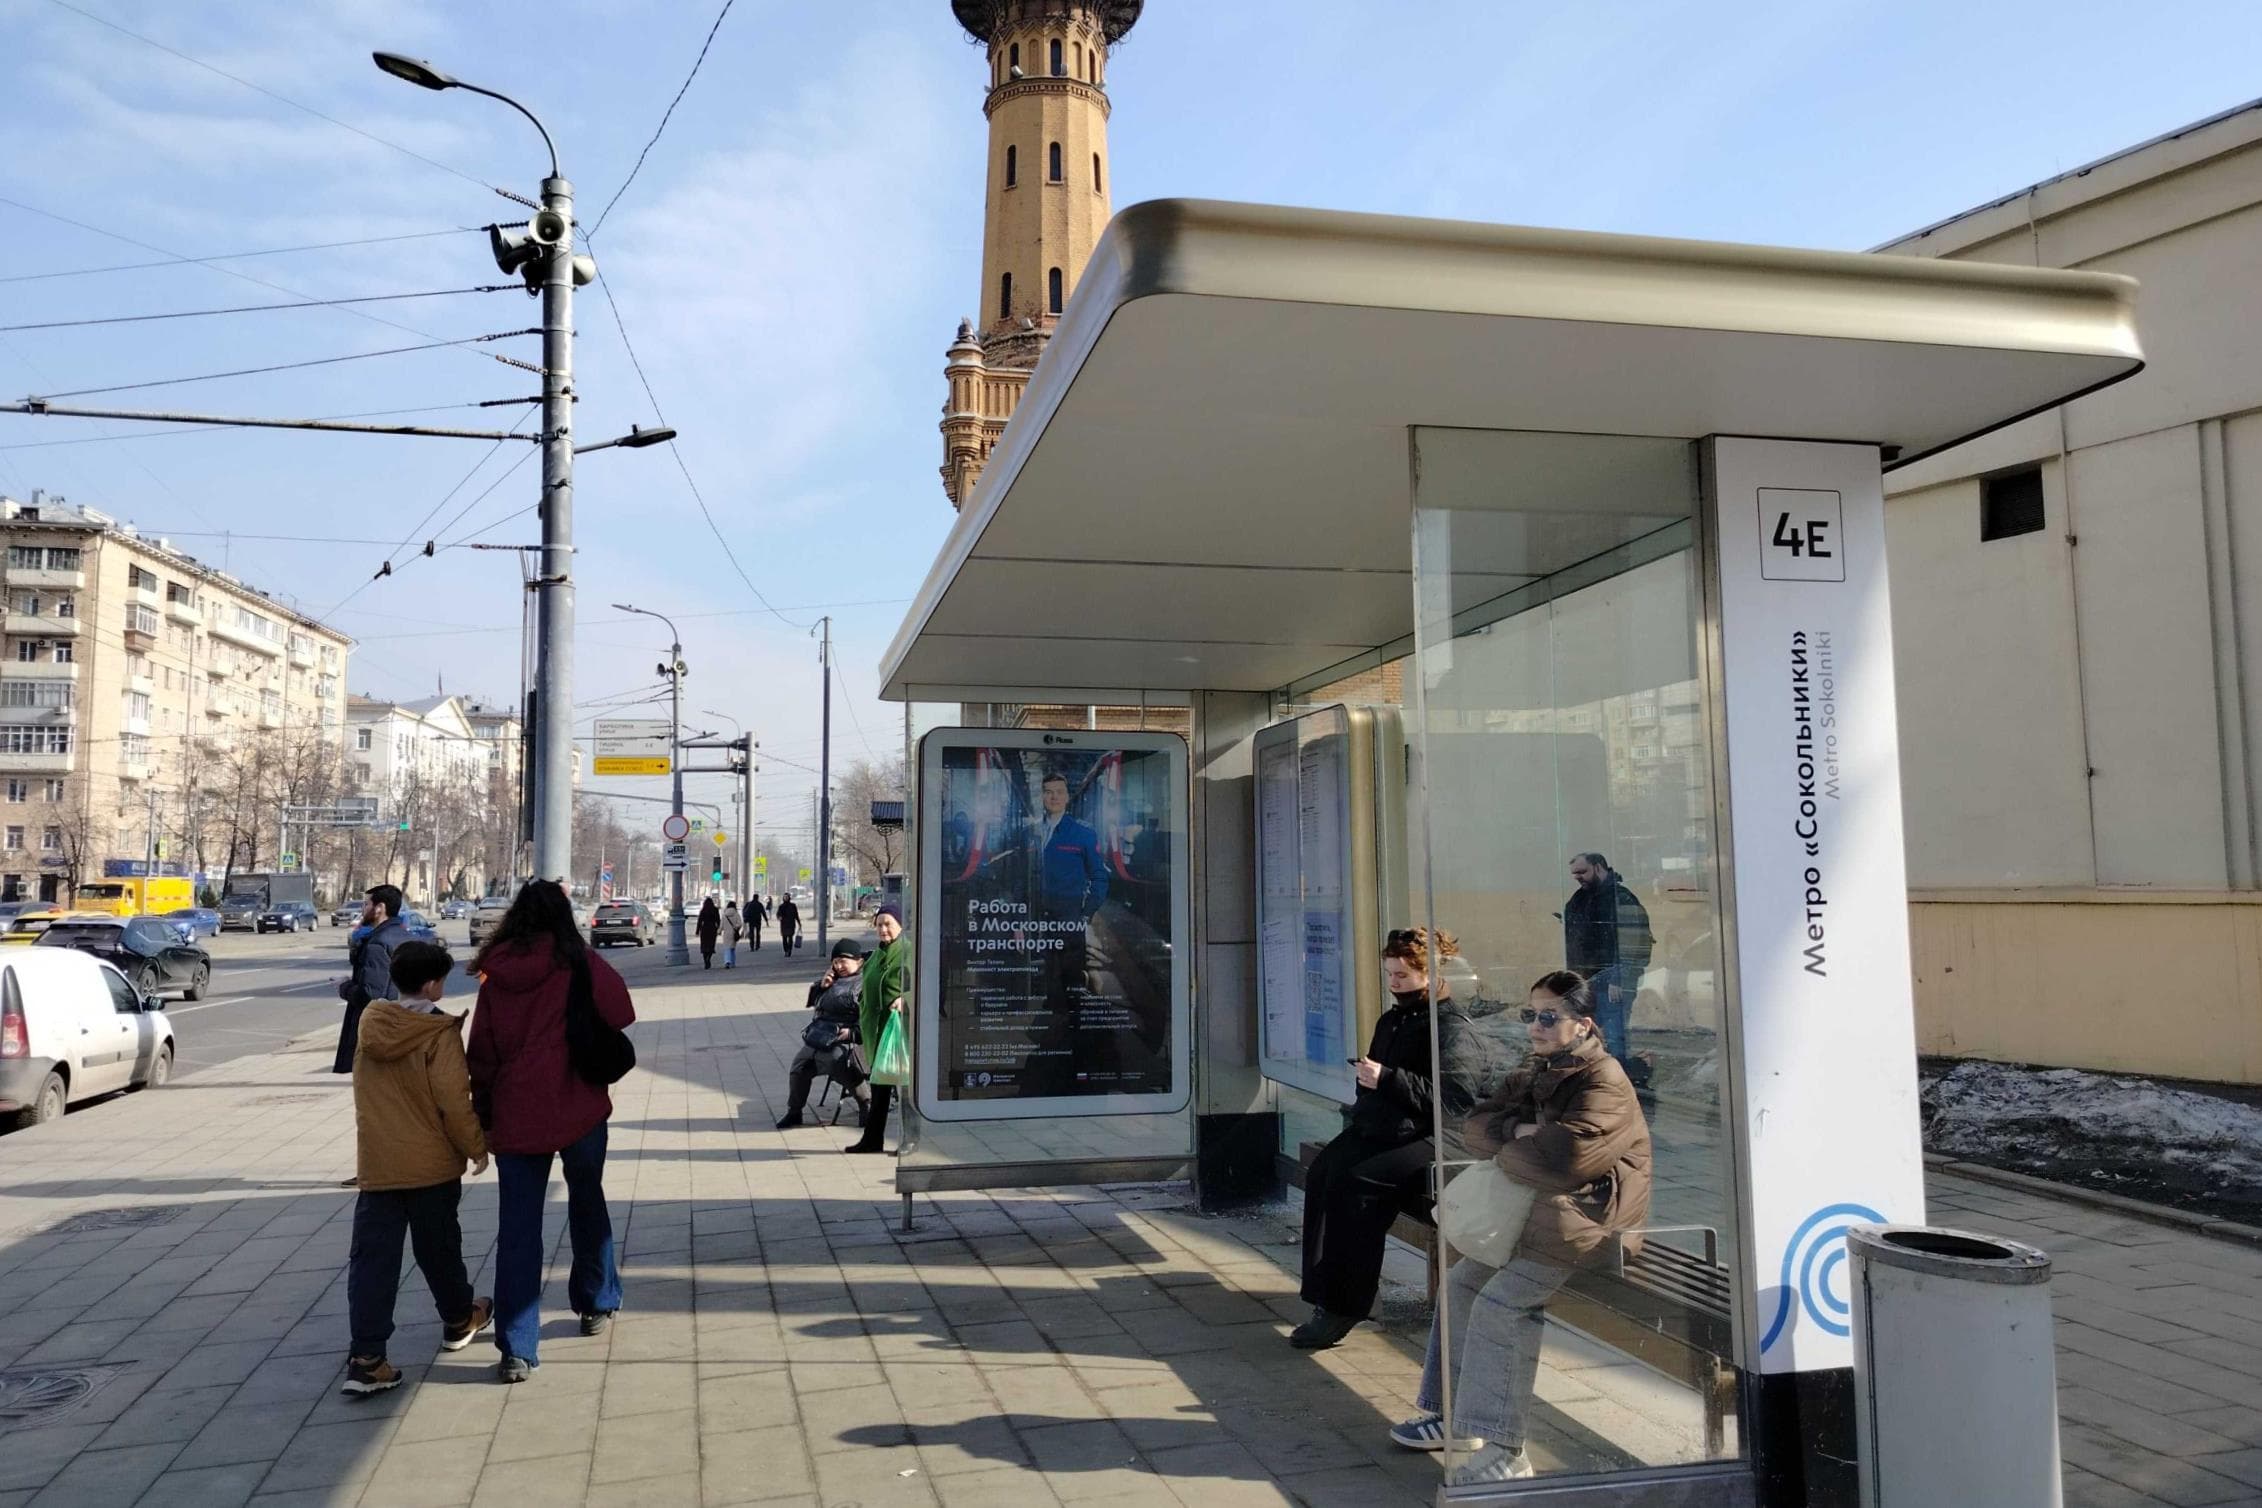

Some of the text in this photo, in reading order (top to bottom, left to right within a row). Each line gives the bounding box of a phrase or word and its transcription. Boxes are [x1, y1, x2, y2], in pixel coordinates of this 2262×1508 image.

[1814, 631, 1840, 800] Metro Sokolniki
[1790, 630, 1827, 978] Метро «Сокольники»
[968, 900, 1028, 914] Работа
[968, 918, 1088, 932] в Московском
[967, 938, 1065, 953] транспорте
